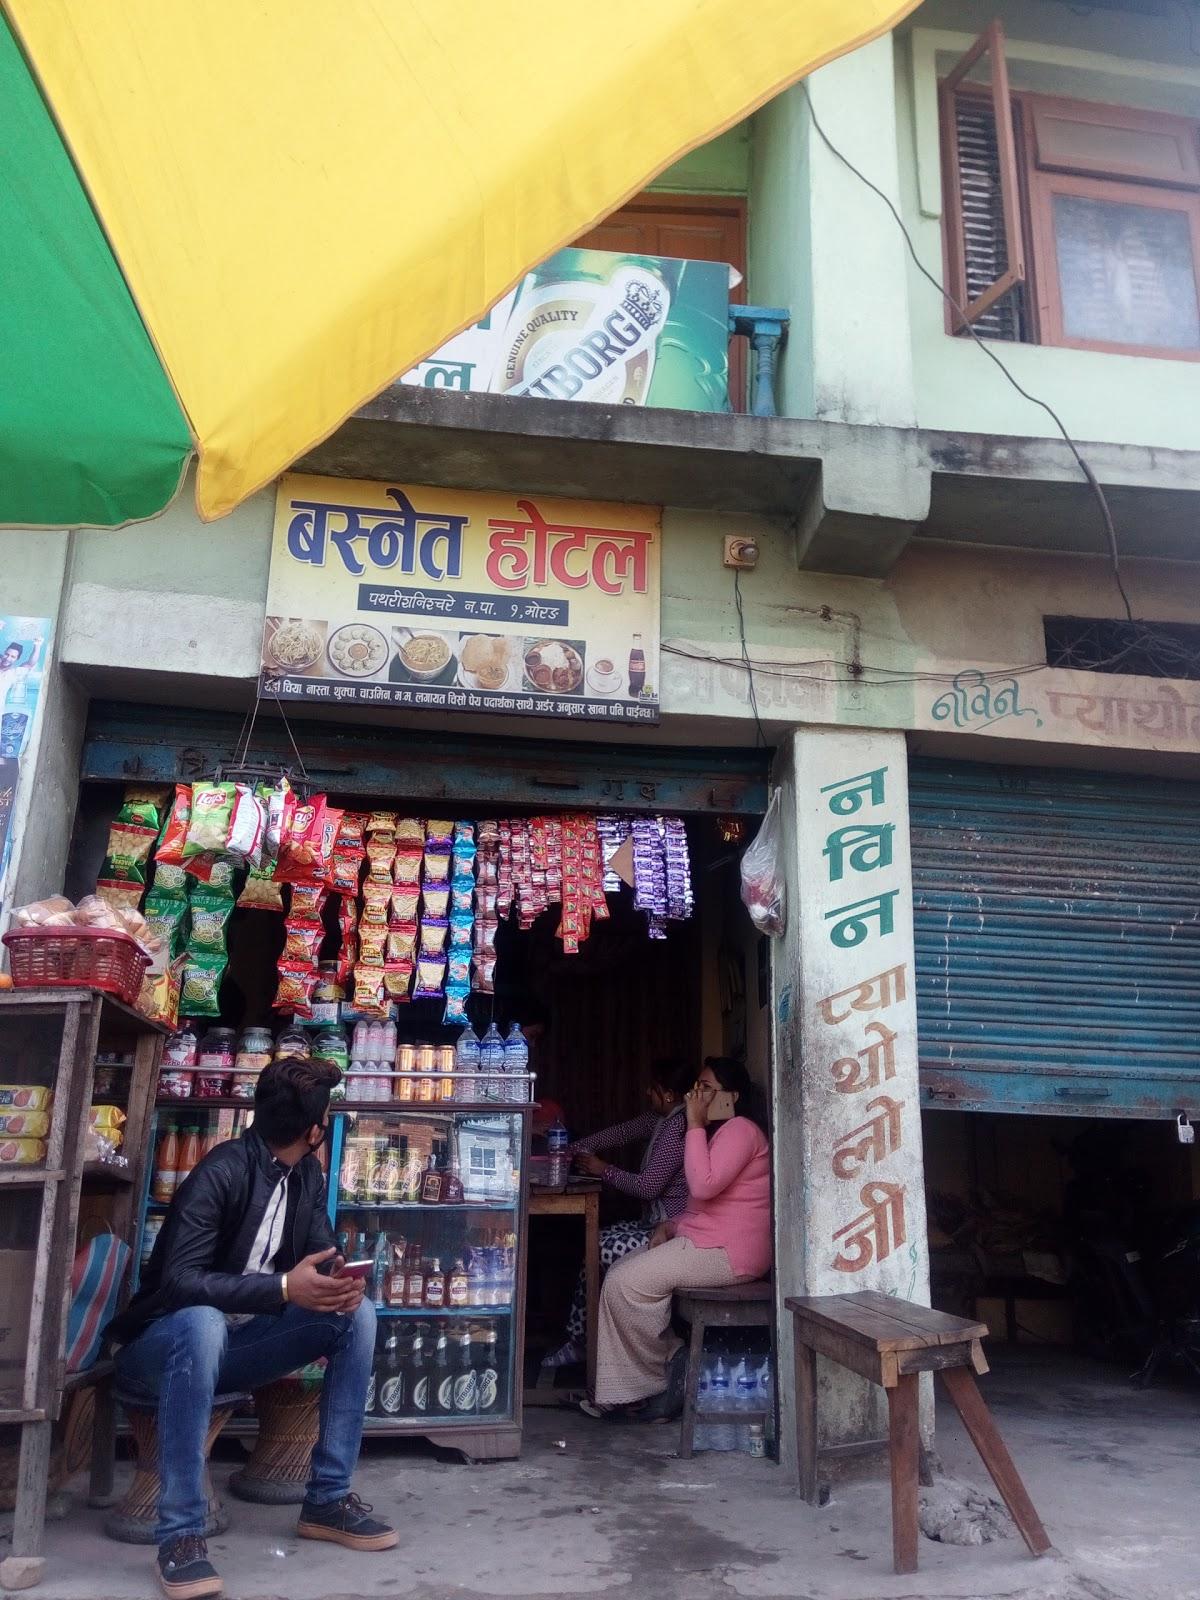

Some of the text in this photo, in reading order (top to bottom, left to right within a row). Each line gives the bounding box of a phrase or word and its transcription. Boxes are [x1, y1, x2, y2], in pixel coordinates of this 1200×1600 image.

[505, 328, 530, 380] GENUINE
[526, 310, 579, 332] QUALITY
[287, 487, 653, 595] बस्नेत होटल
[415, 691, 446, 705] लगायत
[448, 691, 466, 706] चिसो
[468, 693, 481, 706] पेय
[556, 701, 585, 716] अनुसार
[587, 703, 607, 716] खाना
[609, 702, 624, 716] पनि
[456, 1378, 476, 1407] TUBORG
